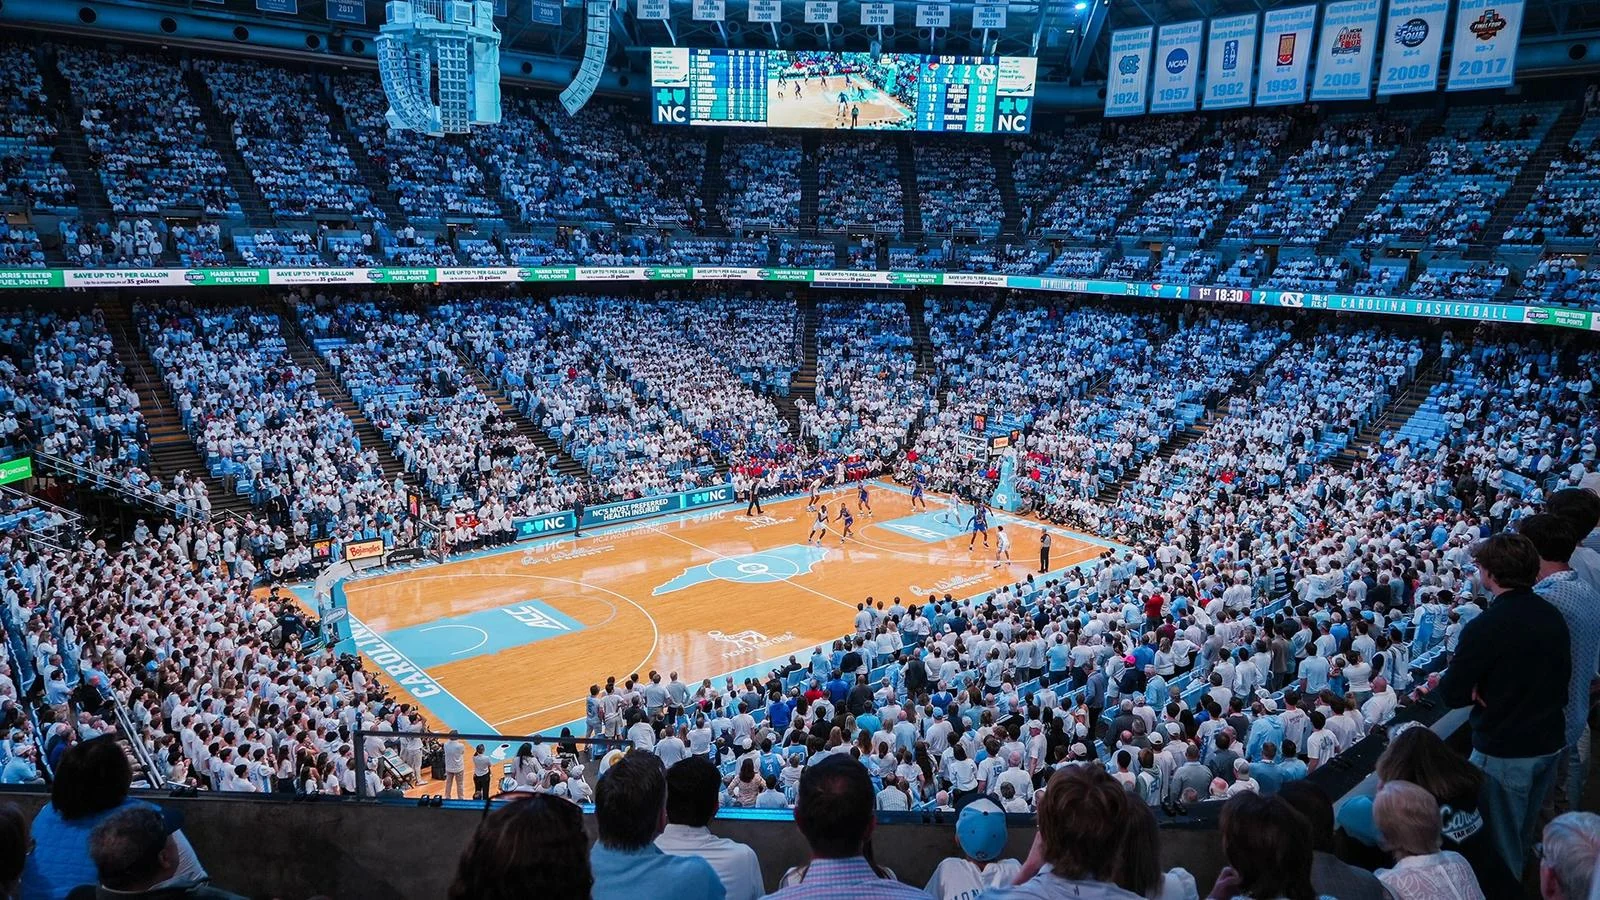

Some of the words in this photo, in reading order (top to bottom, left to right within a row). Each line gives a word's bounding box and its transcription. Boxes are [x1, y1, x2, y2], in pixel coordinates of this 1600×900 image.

[1401, 30, 1425, 39] FOUR
[1341, 40, 1361, 48] FOUR
[1168, 60, 1187, 68] NCAA
[1458, 58, 1506, 76] 2017
[948, 65, 954, 77] 2
[965, 65, 970, 78] 2
[1387, 64, 1430, 81] 2009
[1265, 78, 1297, 92] 1993
[1323, 72, 1360, 86] 2005
[1160, 87, 1189, 100] 1957
[1212, 82, 1244, 96] 1982
[928, 94, 936, 102] 12
[1113, 91, 1139, 104] 1924
[658, 106, 686, 122] NC
[998, 115, 1027, 131] NC
[1176, 287, 1182, 298] 2
[1199, 288, 1211, 299] 1ST
[1215, 289, 1243, 302] 18:30
[1259, 292, 1266, 304] 2
[1341, 297, 1407, 313] CAROLINA
[1416, 303, 1508, 319] BASKETBALL
[710, 489, 726, 500] NC
[592, 508, 609, 517] NC'S
[610, 505, 630, 514] MOST
[631, 499, 668, 510] PREFERRED
[603, 510, 630, 520] HEALTH
[632, 506, 660, 516] INSURER
[545, 517, 565, 530] NC
[350, 544, 380, 556] Bojangles
[501, 606, 562, 630] ACC
[1454, 831, 1465, 839] TAR
